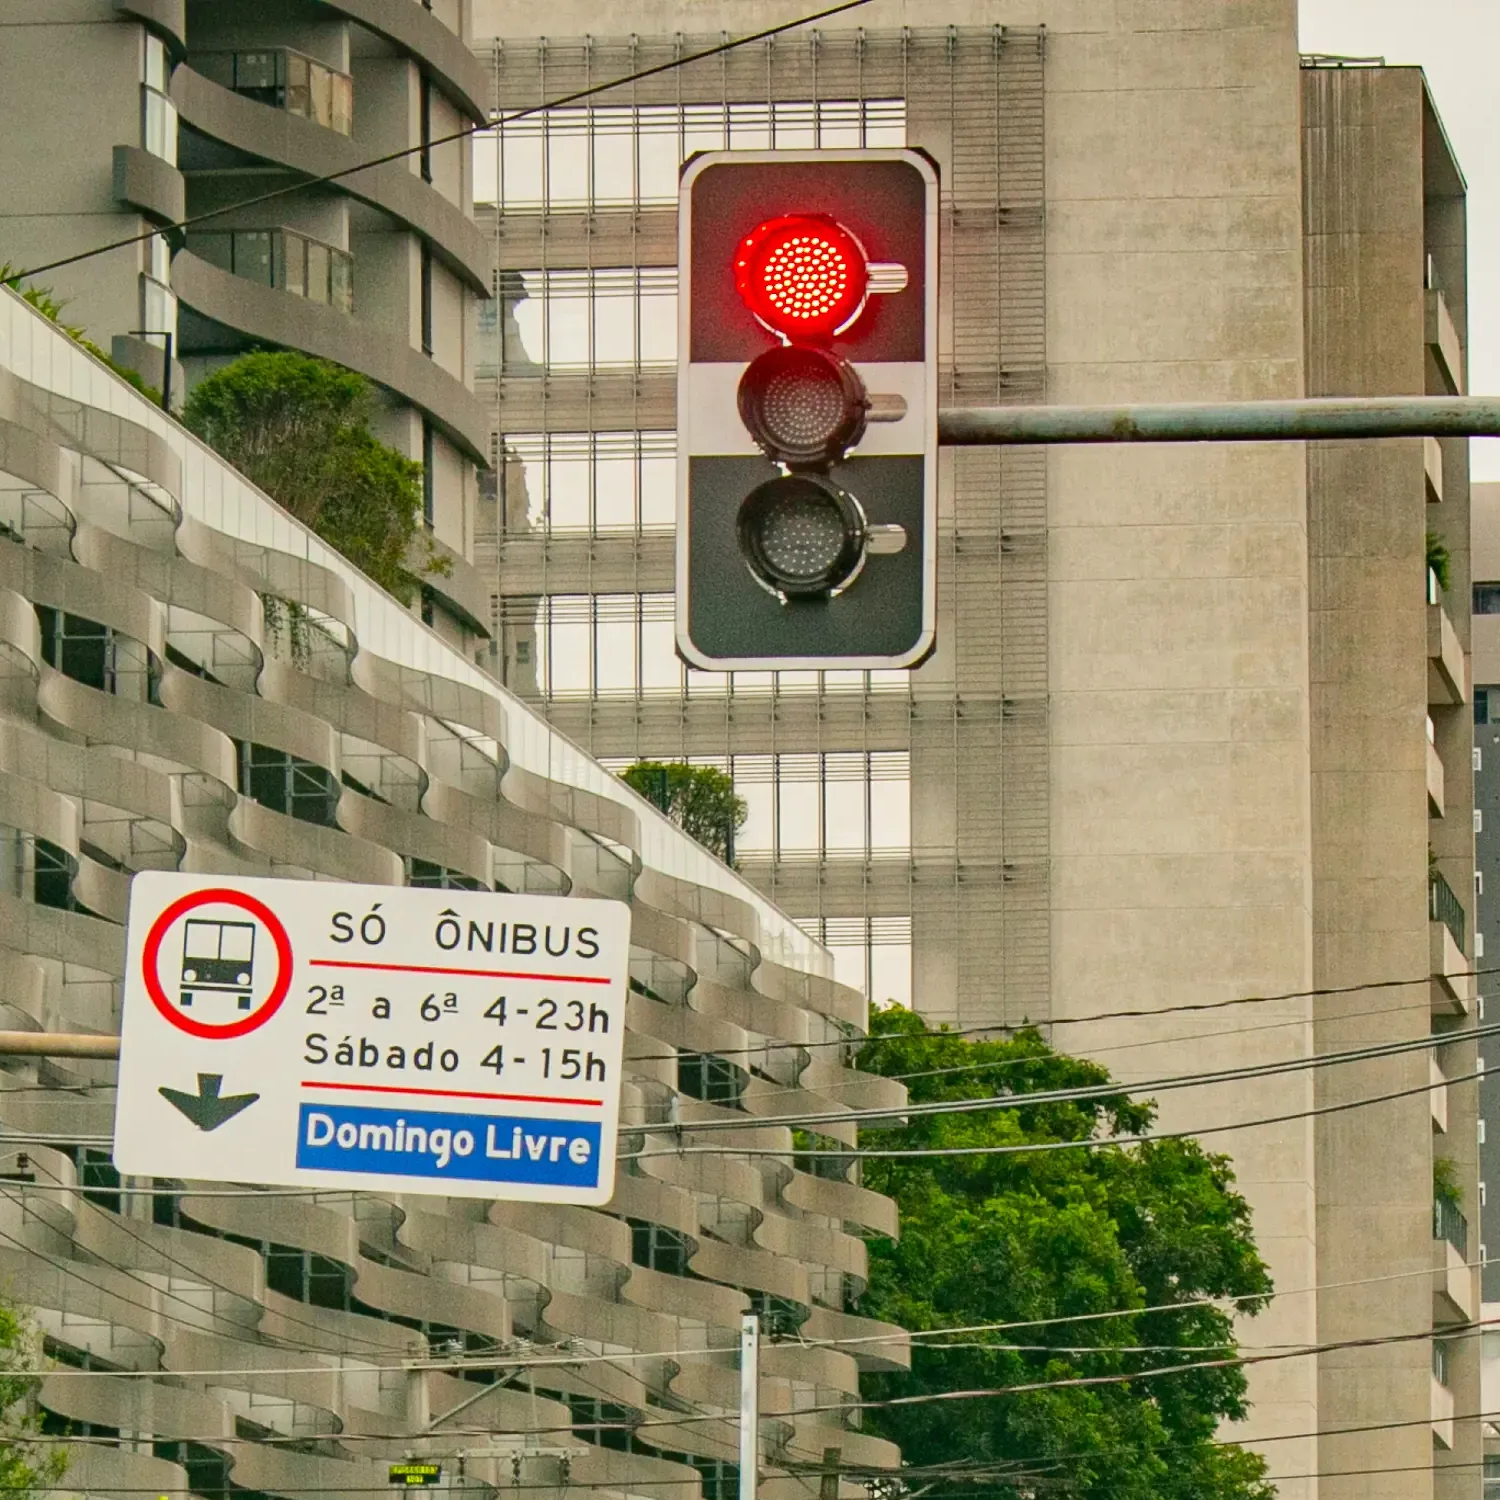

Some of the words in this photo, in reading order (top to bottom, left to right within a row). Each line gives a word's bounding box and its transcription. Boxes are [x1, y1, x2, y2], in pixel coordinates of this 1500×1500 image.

[329, 903, 387, 945] SÓ
[435, 908, 600, 959] ÔNIBUS
[371, 997, 391, 1019] a
[304, 1032, 459, 1072] Sábado
[306, 1112, 475, 1169] Domingo
[486, 1124, 591, 1165] Livre
